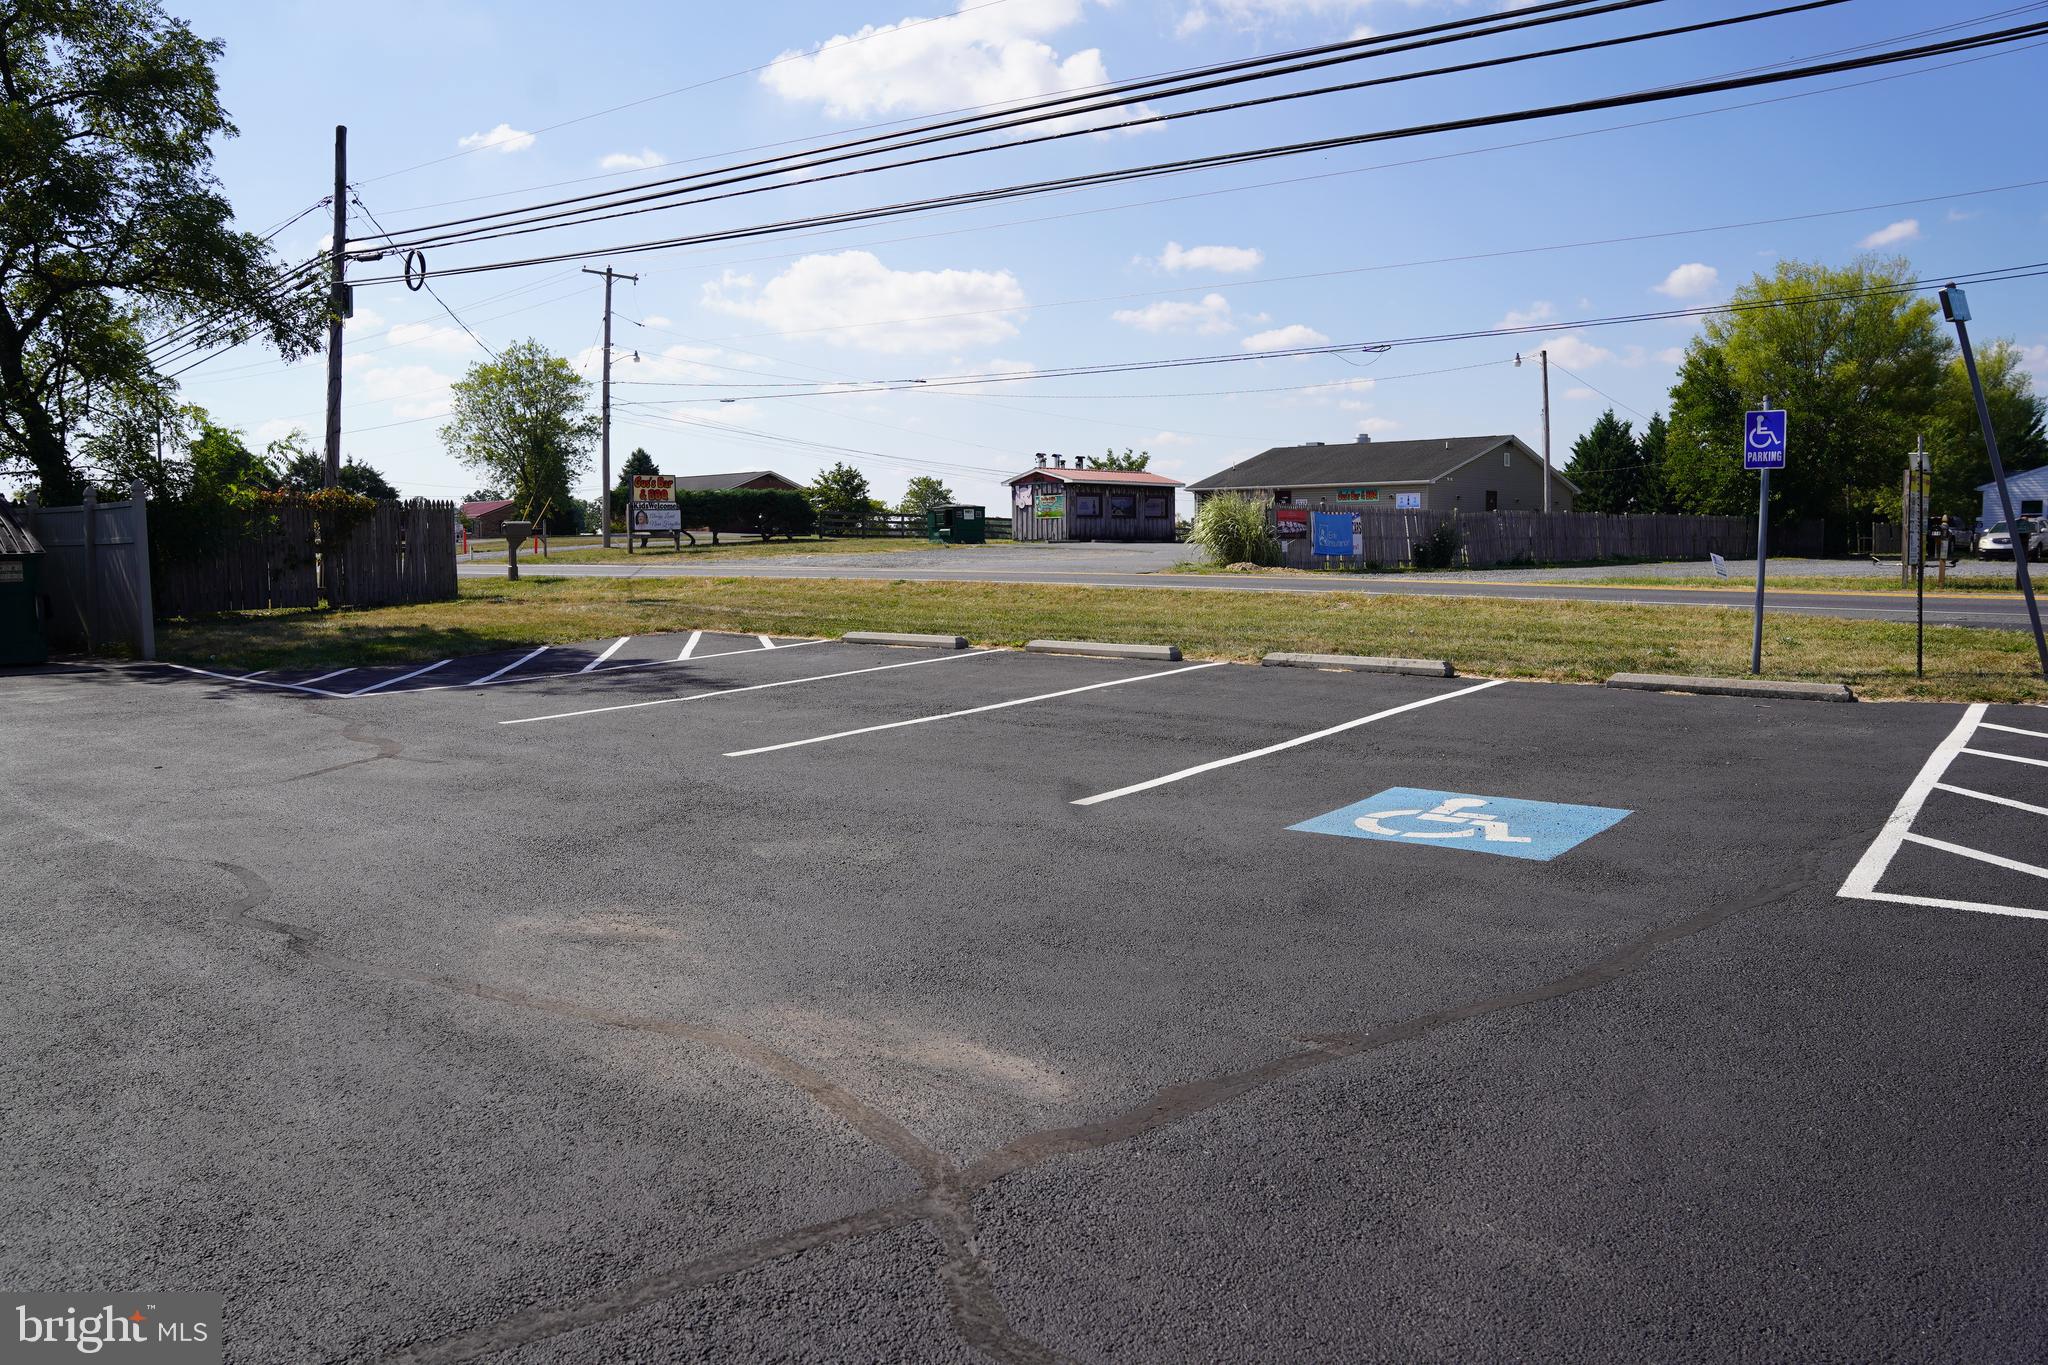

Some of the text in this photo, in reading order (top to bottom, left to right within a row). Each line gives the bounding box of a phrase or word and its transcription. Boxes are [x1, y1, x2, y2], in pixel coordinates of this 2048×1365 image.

[1747, 450, 1782, 462] PARKING
[634, 476, 673, 488] Gus's Bar
[648, 489, 669, 501] BBQ
